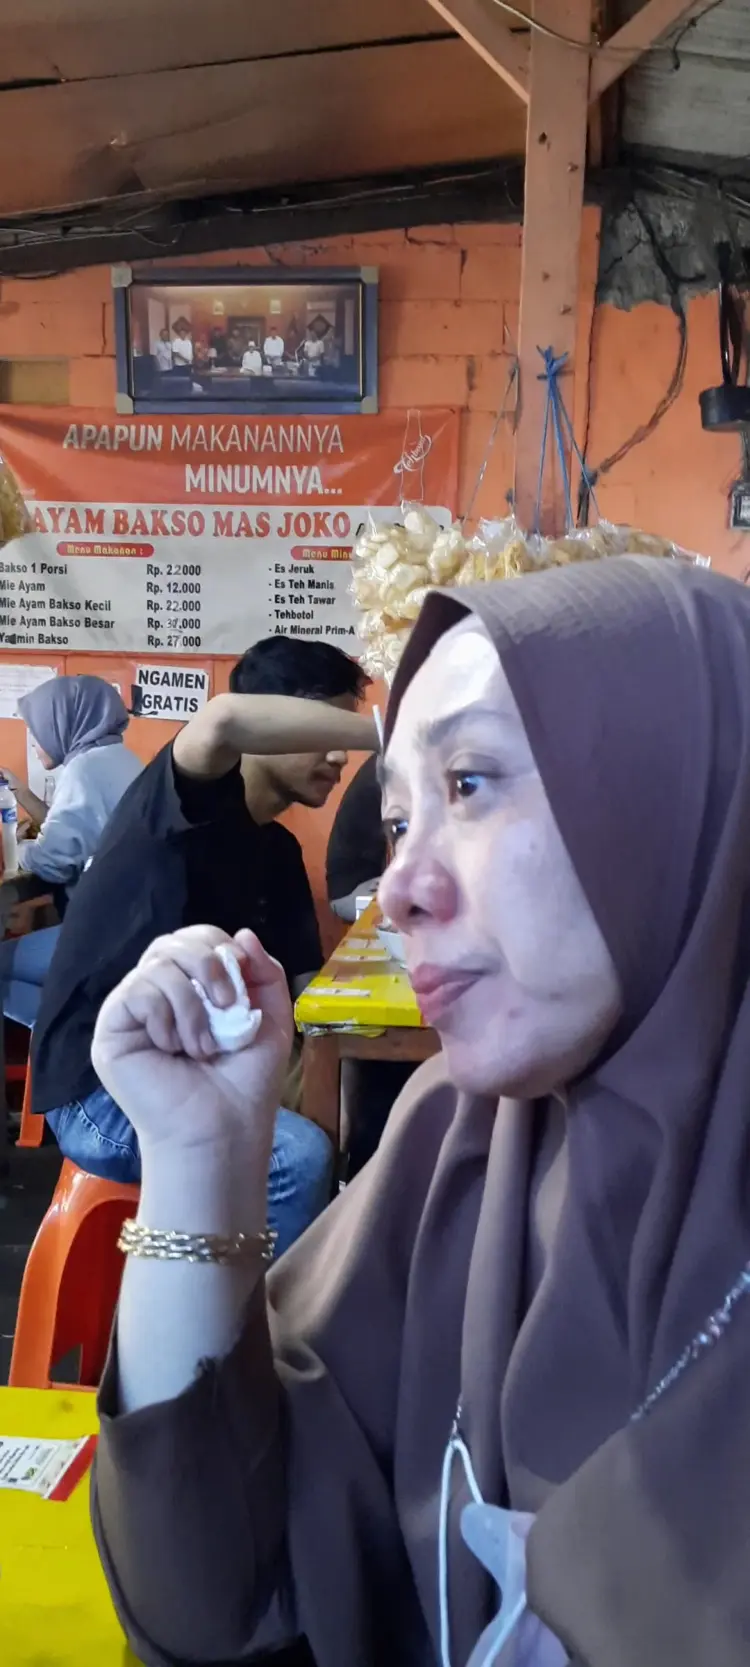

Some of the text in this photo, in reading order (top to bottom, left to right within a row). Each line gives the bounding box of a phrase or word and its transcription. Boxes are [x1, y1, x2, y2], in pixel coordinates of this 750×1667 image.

[62, 423, 344, 453] APAPUN MAKANANNYA
[185, 463, 343, 495] MINUMNYA...
[112, 508, 206, 537] BAKSO
[212, 510, 271, 538] MAS
[276, 511, 351, 539] JOKO
[67, 544, 92, 554] Menu
[93, 545, 137, 556] Makanan
[302, 548, 328, 559] Menu
[0, 562, 68, 575] Bakso 1 Porsi
[146, 564, 163, 578] Rp.
[274, 563, 315, 574] Es Jeruk
[0, 580, 46, 594] Mie Ayam
[146, 582, 201, 595] Rp. 12.000
[274, 579, 335, 590] Es Teh Manis
[0, 597, 112, 611] Mie Ayam Bakso Kecil
[274, 594, 337, 605] Es Teh Tawar
[146, 600, 163, 613] Rp.
[274, 609, 314, 620] Tehbotol
[0, 615, 116, 629] Mie Ayam Bakso Besar
[147, 617, 164, 631] Rp.
[274, 625, 288, 635] Air
[290, 625, 323, 635] Mineral
[38, 633, 69, 645] Bakso
[147, 635, 164, 648] Rp.
[138, 669, 205, 690] NGAMEN
[142, 693, 199, 713] GRATIS
